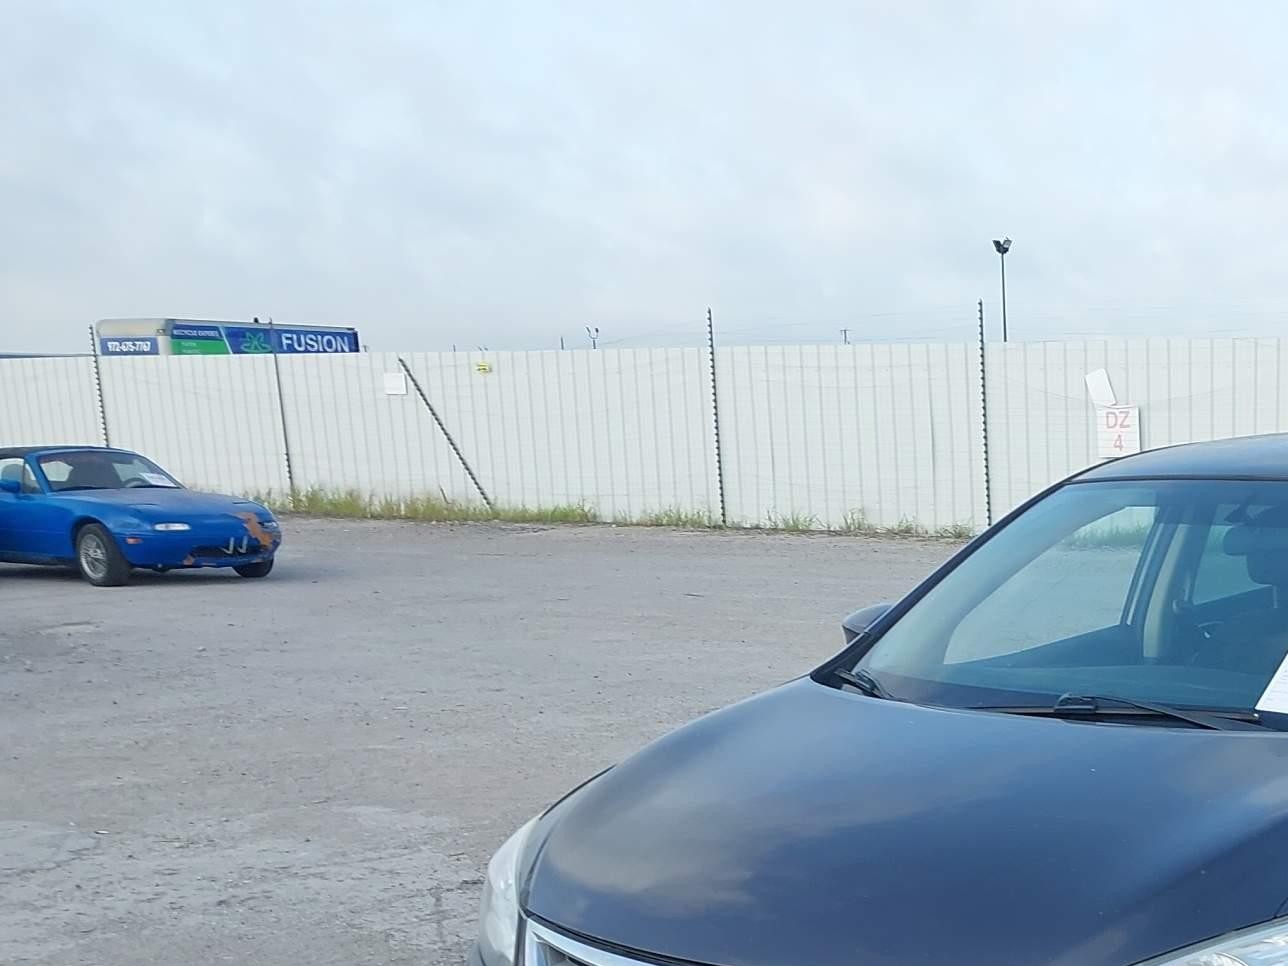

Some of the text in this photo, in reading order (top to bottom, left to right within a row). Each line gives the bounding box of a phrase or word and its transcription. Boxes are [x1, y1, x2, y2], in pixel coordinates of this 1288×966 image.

[281, 333, 350, 353] FUSION
[1105, 410, 1131, 429] DZ
[1112, 433, 1125, 452] 4
